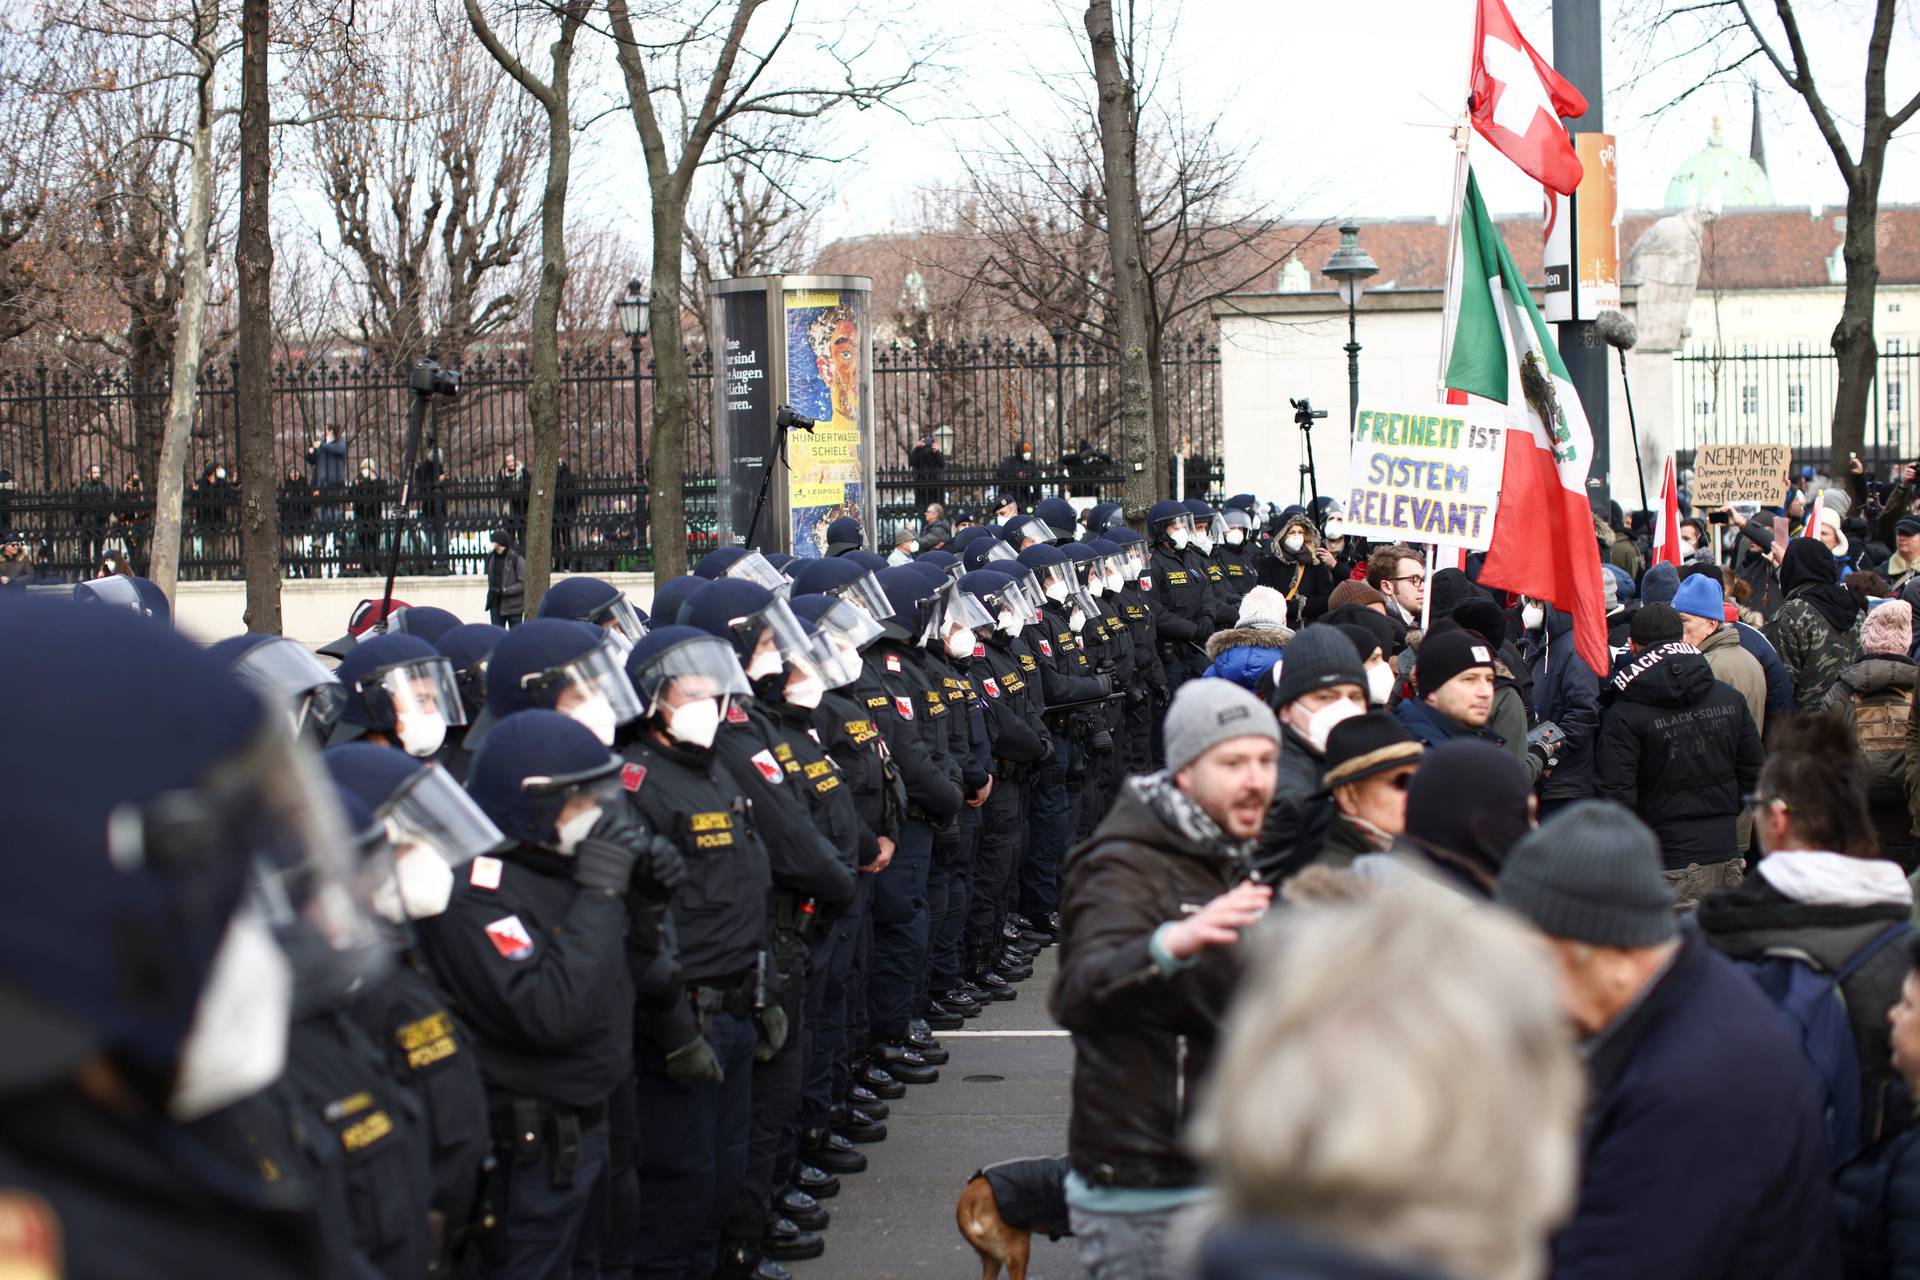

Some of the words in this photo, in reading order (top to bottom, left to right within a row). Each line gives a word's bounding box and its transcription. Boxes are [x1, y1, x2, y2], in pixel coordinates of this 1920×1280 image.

[734, 350, 756, 365] sind
[732, 367, 763, 383] Augen
[1356, 410, 1465, 449] FREIHEIT
[1467, 425, 1502, 451] IST
[811, 446, 848, 457] SCHIELE
[1368, 452, 1470, 494] SYSTEM
[1697, 465, 1776, 478] Demonstranten
[1700, 480, 1718, 490] wie
[1720, 477, 1734, 489] die
[1737, 476, 1769, 488] Viren
[1347, 488, 1488, 538] RELEVANT
[1653, 704, 1736, 730] BLACK-SQUAD
